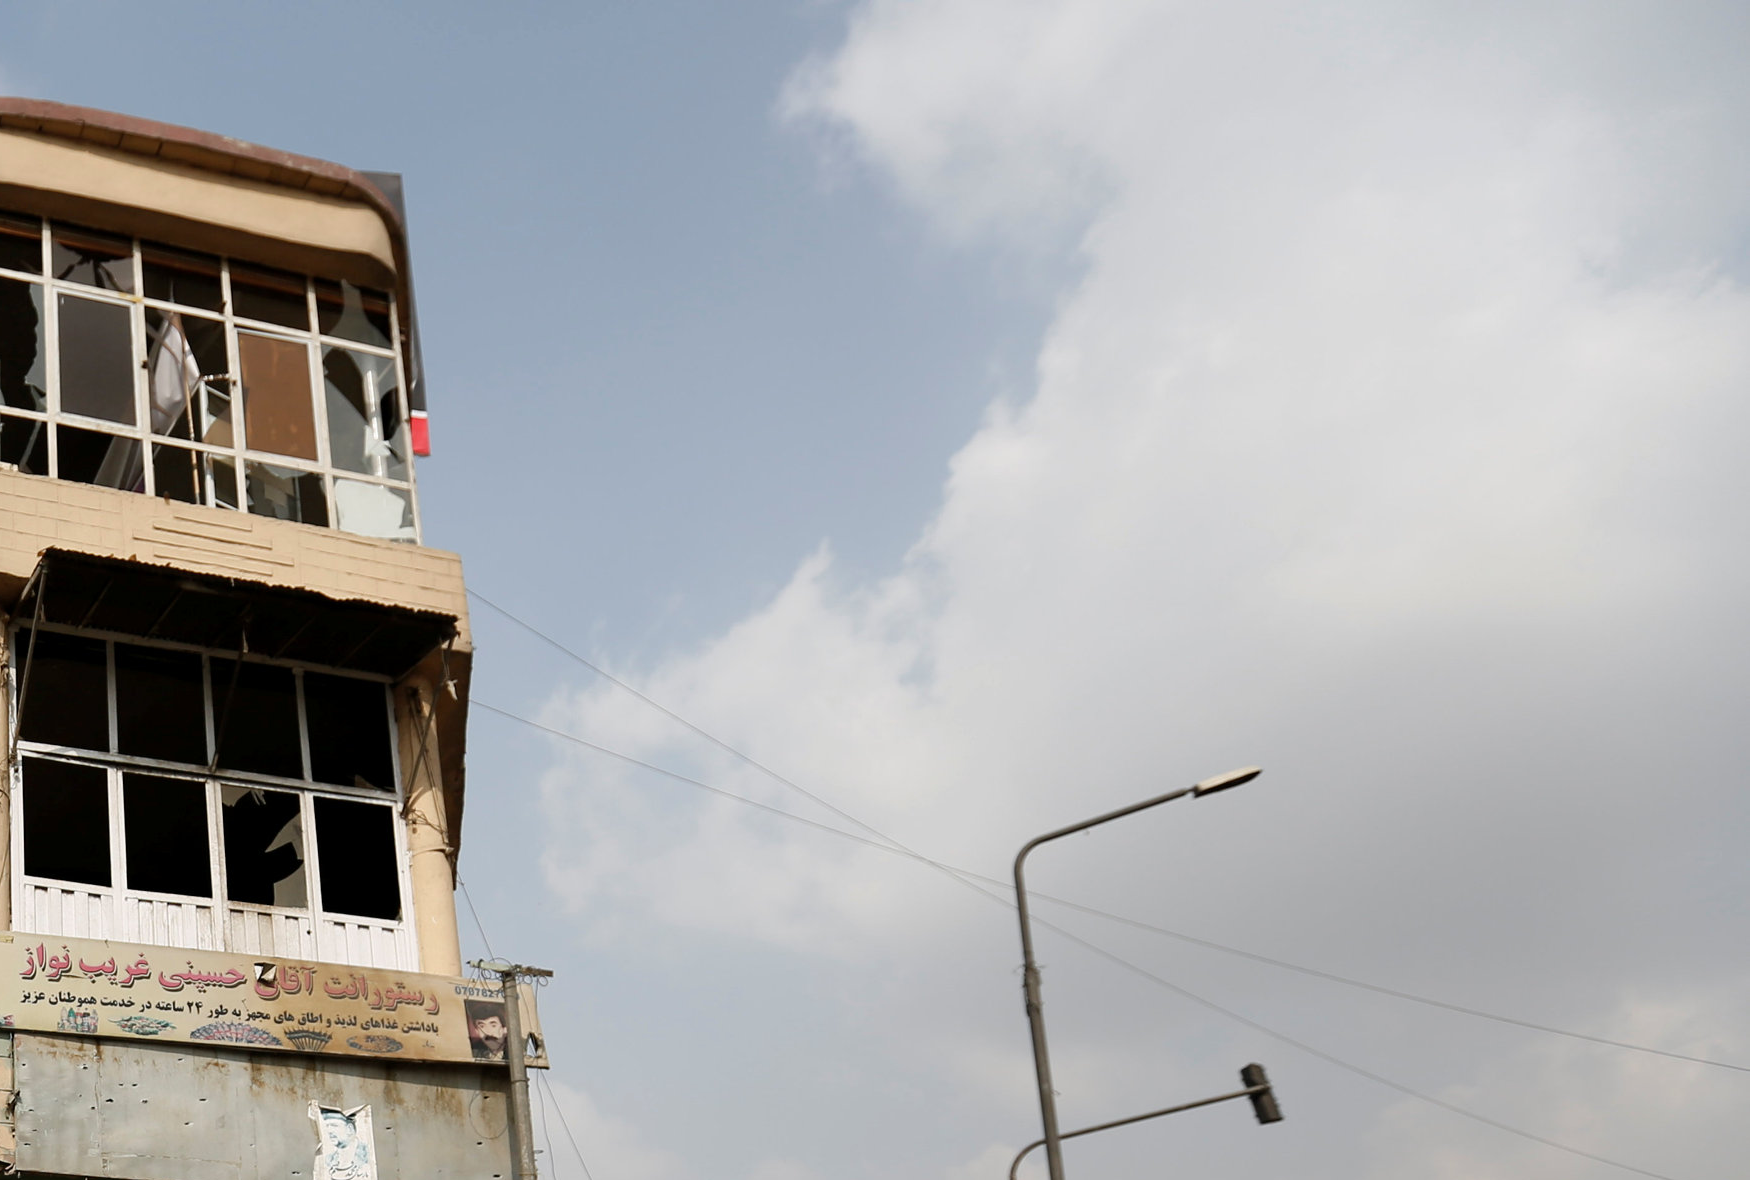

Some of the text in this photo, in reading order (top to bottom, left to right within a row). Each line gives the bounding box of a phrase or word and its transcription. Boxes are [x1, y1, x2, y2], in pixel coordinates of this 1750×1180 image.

[19, 941, 72, 981] نواز
[79, 952, 152, 987] غریب
[158, 960, 247, 993] حسینی
[20, 989, 46, 1005] عزیز
[48, 991, 97, 1008] هموطنان
[100, 996, 135, 1008] خدمت
[324, 974, 441, 1015] رستورانت
[139, 1000, 152, 1013] در
[155, 1001, 185, 1013] ساعته
[207, 1004, 228, 1018] طور
[231, 1008, 241, 1020] به
[245, 1008, 271, 1023] مجهز
[273, 1010, 295, 1025] های
[297, 1012, 323, 1026] اطاق
[326, 1018, 332, 1028] و
[334, 1015, 357, 1031] لذیذ
[360, 1018, 398, 1031] غذاهای
